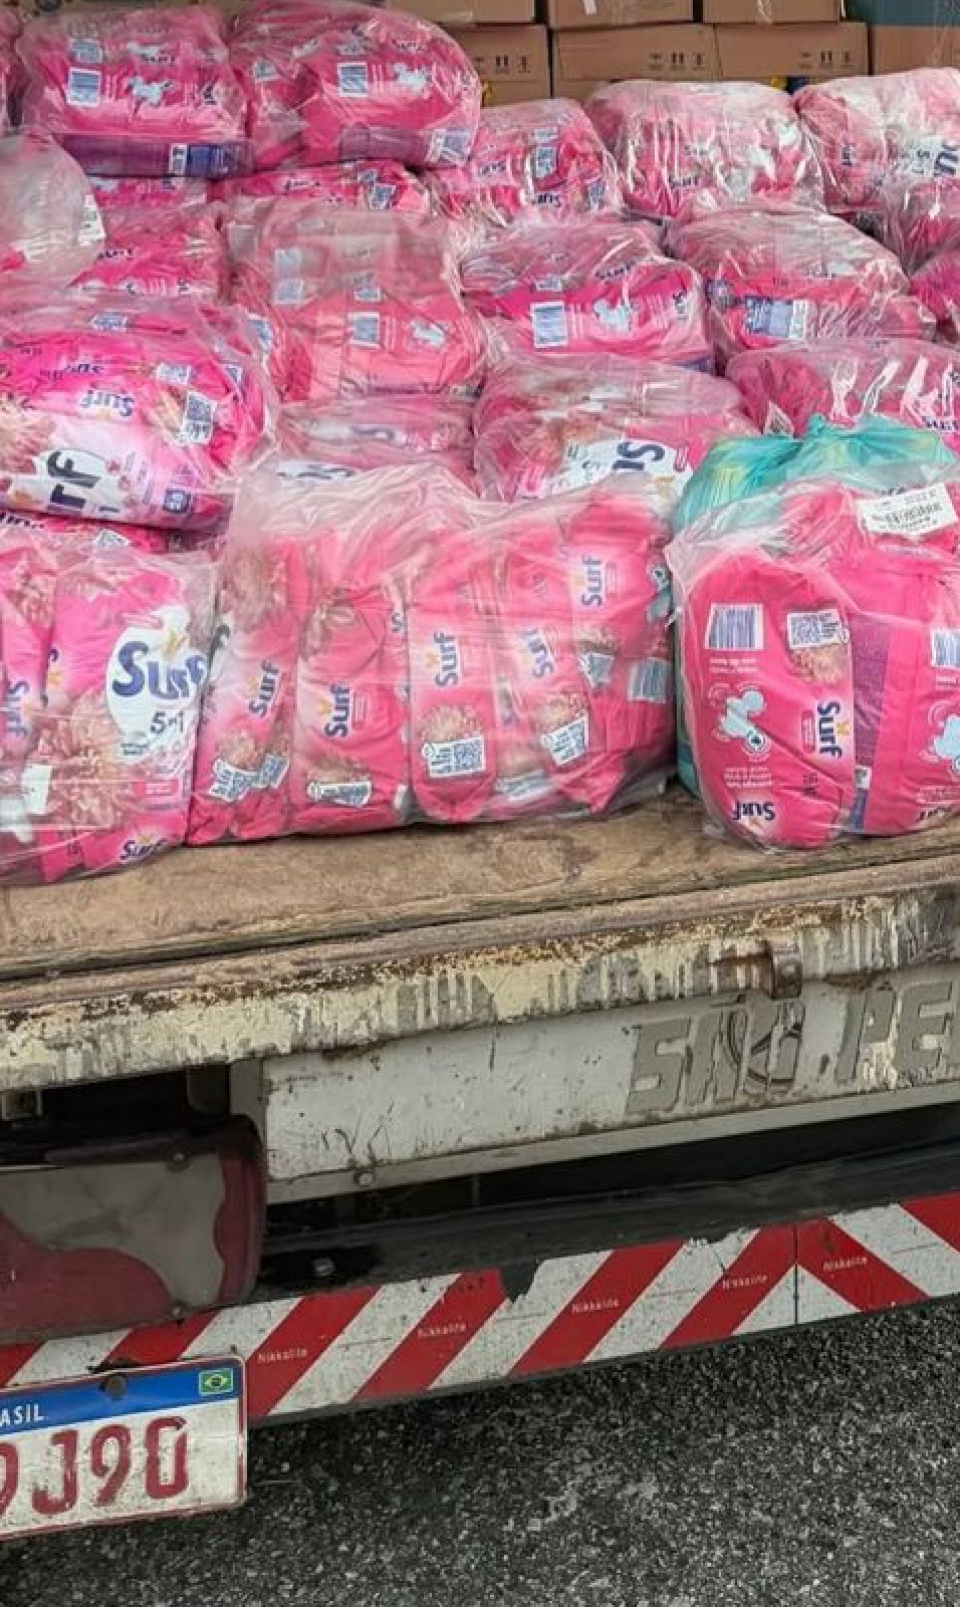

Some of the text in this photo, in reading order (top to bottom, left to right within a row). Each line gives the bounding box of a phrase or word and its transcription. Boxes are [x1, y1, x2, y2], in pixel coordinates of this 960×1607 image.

[582, 555, 603, 607] Surf
[433, 631, 458, 687] Surf
[249, 658, 281, 719] Surf
[324, 682, 351, 739] Surf
[816, 700, 843, 759] Surf
[731, 800, 776, 822] Surf
[0, 1403, 45, 1427] ASIL
